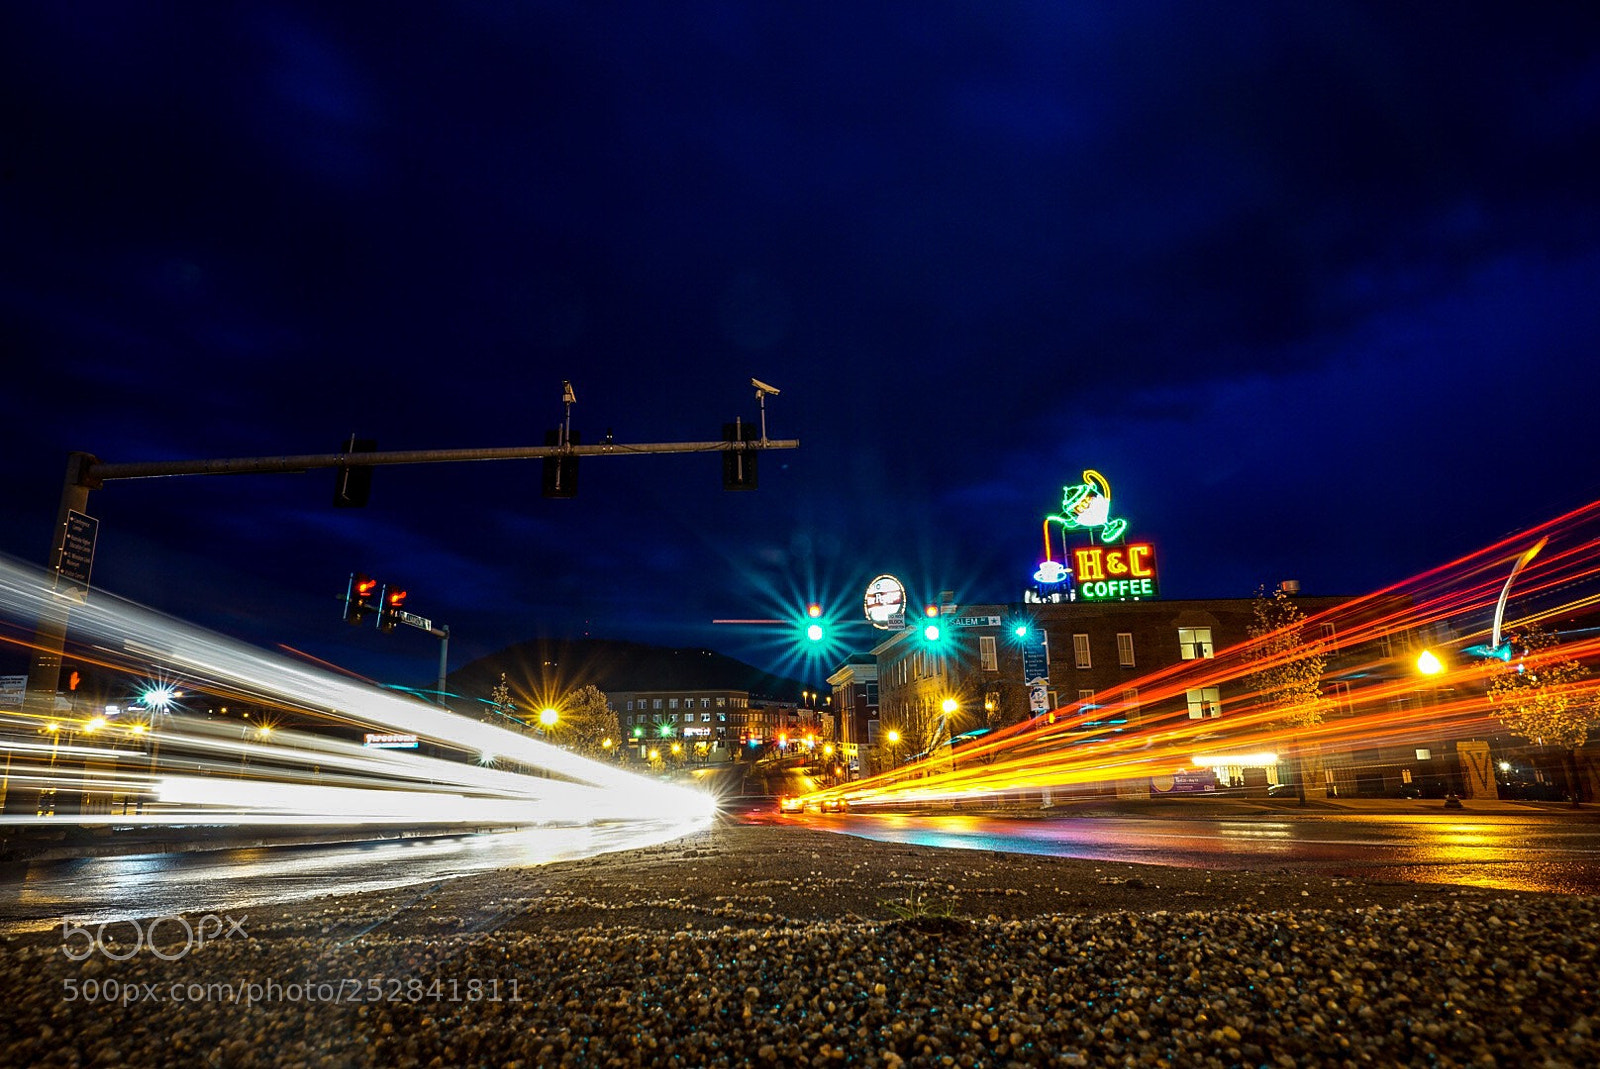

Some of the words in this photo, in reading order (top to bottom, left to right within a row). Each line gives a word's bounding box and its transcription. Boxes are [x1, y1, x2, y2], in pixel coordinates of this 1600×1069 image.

[1075, 549, 1105, 581] H
[1106, 552, 1128, 574] &
[1129, 546, 1151, 577] C
[1082, 578, 1153, 597] COFFEE
[951, 617, 978, 626] SALEM
